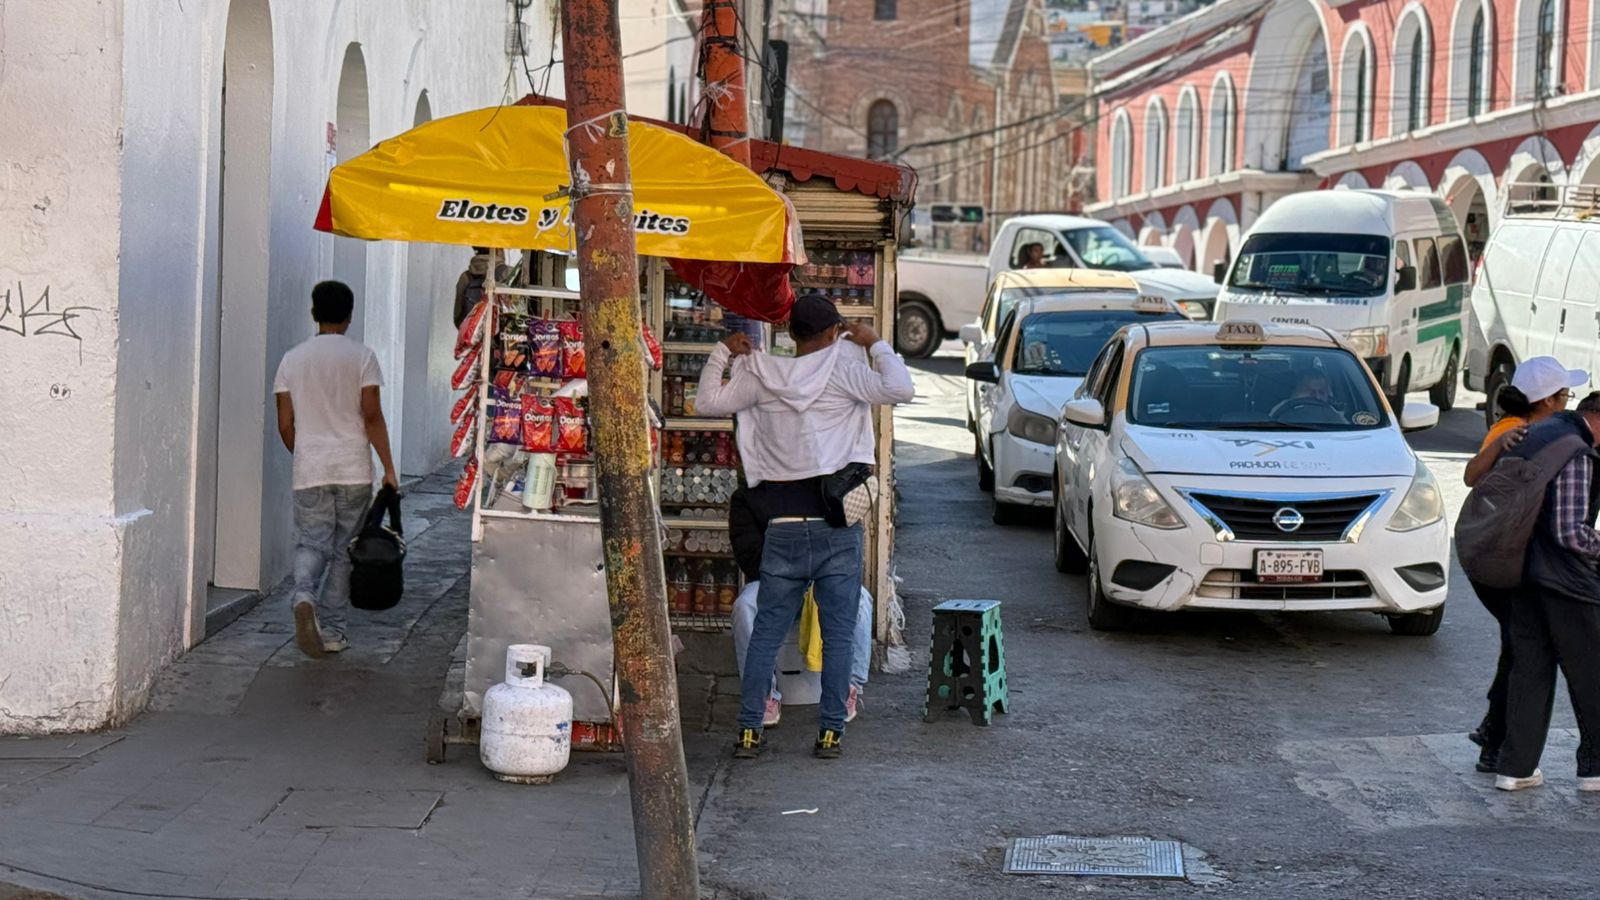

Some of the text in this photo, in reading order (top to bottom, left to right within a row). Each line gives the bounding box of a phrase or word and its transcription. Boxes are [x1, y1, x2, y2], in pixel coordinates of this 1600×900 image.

[438, 199, 528, 223] Elotes
[538, 208, 559, 228] y
[1271, 316, 1311, 326] CENTRAL
[1226, 323, 1257, 334] TAXI
[559, 415, 585, 425] Dorit
[1229, 461, 1281, 469] PACHUCA
[1260, 559, 1321, 574] A-895-FVB
